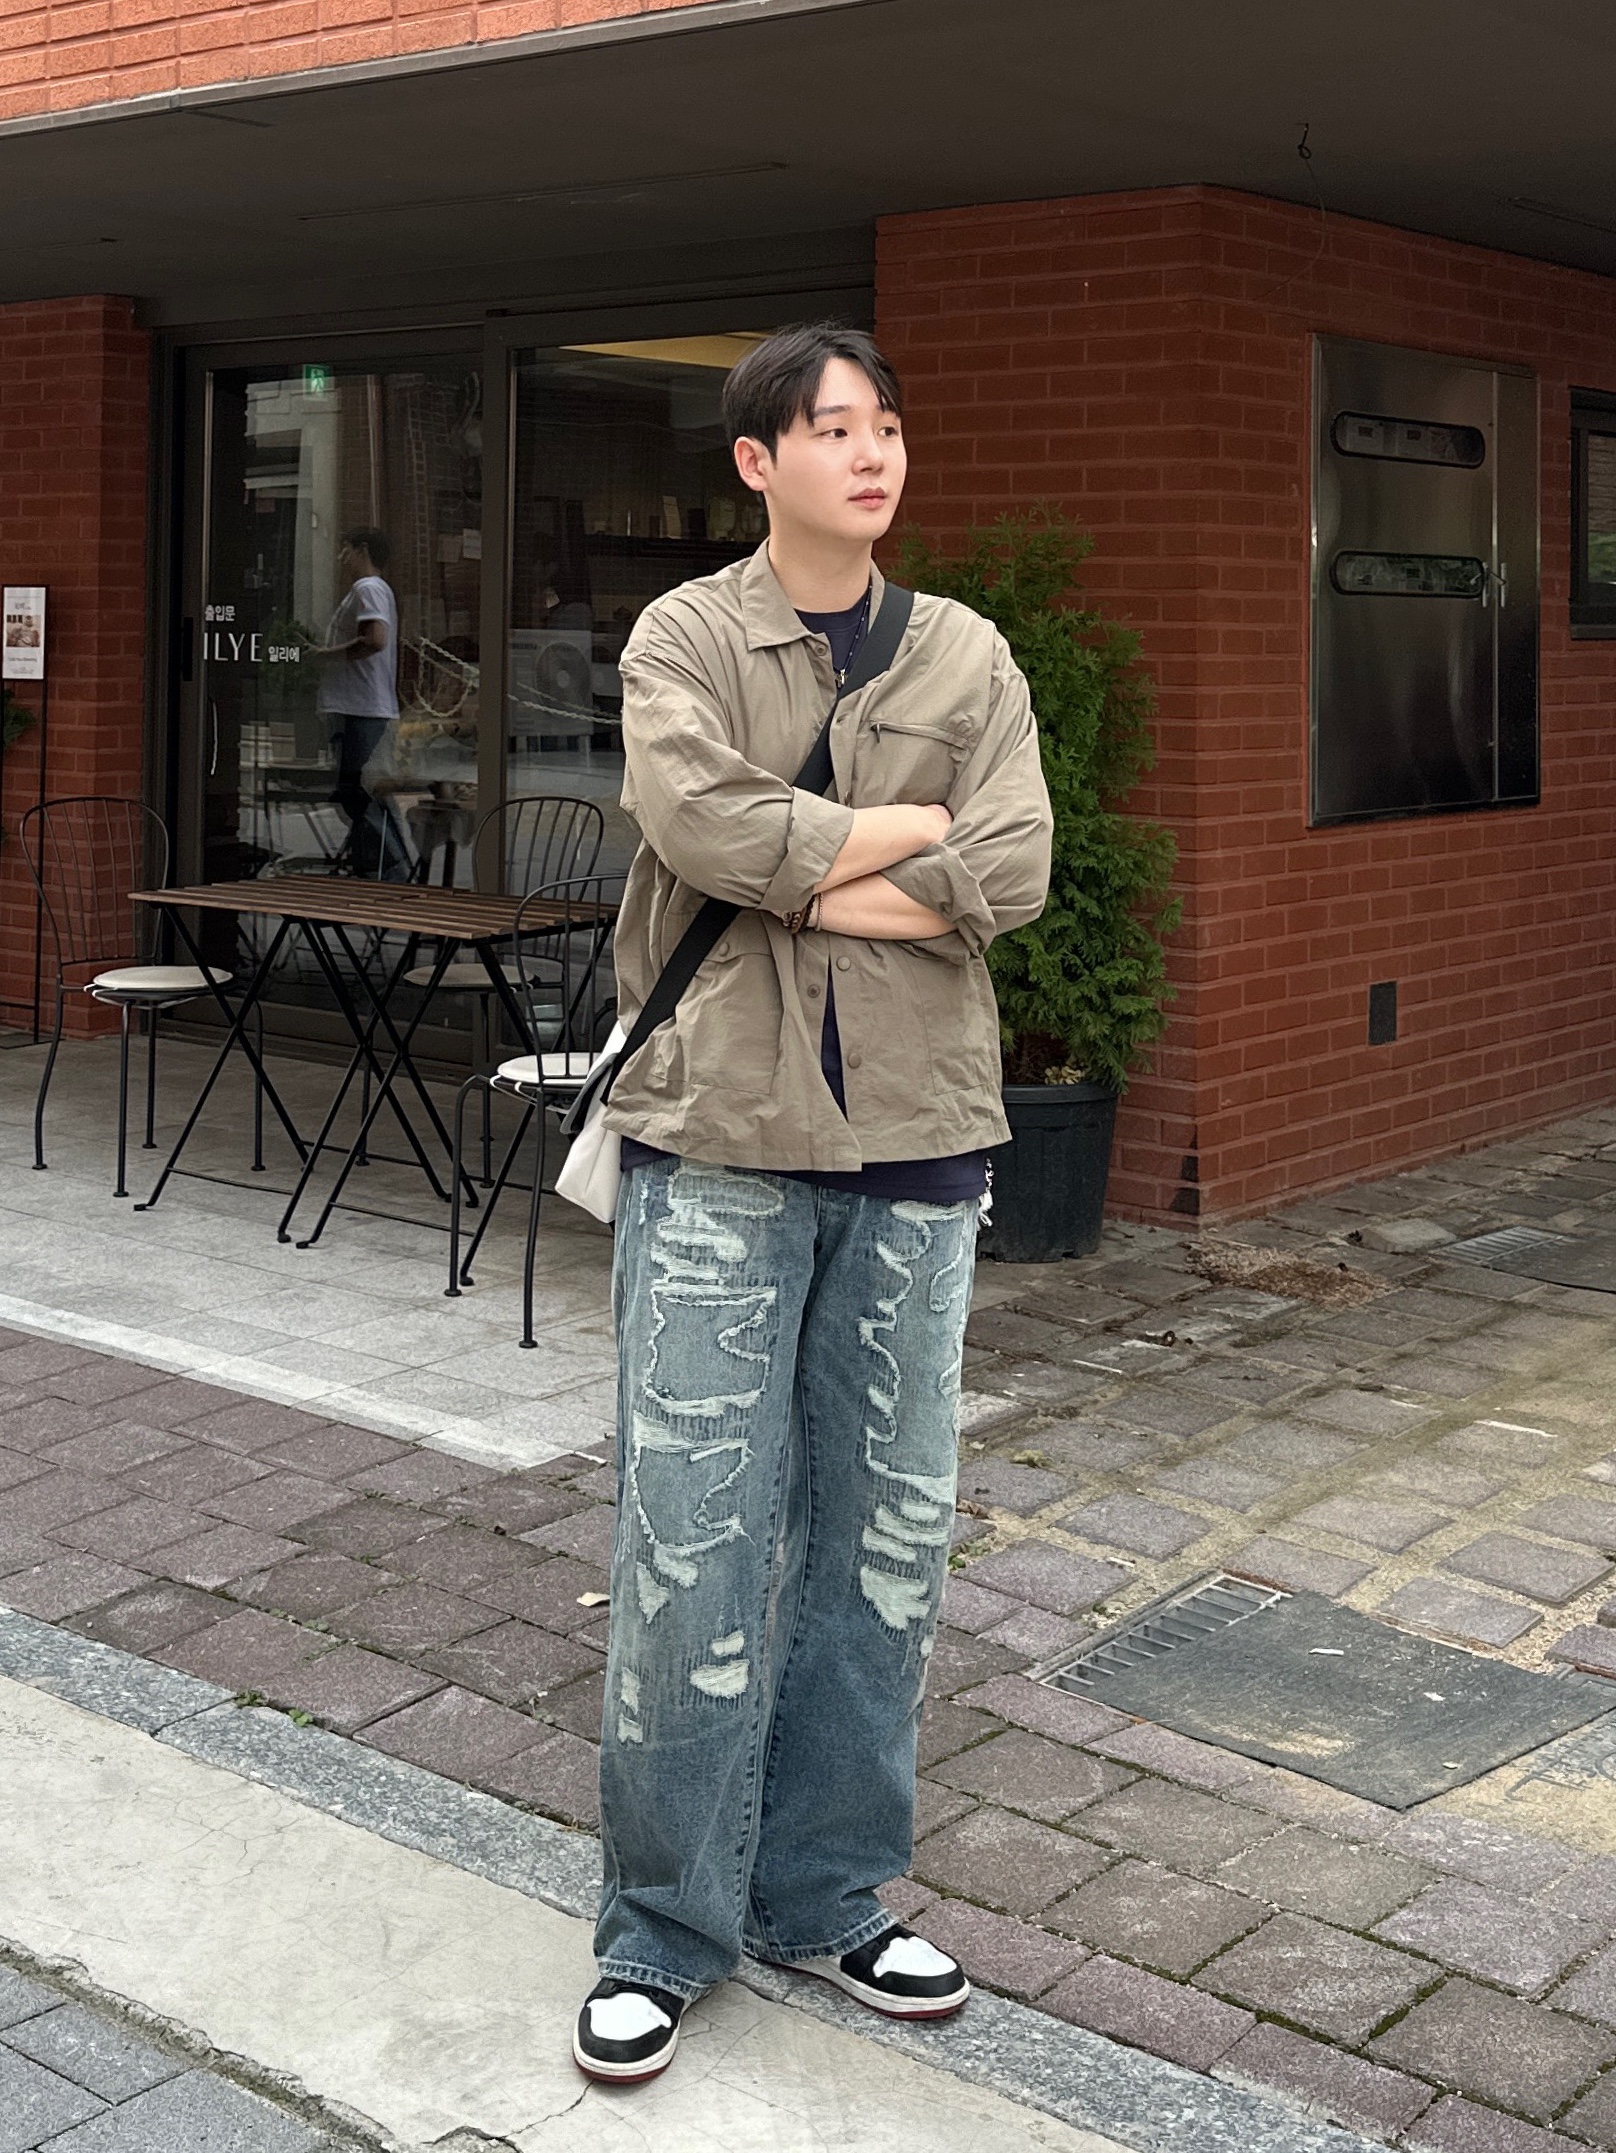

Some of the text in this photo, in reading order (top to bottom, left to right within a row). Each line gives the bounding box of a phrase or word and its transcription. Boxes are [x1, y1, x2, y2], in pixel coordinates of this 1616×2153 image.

[205, 604, 236, 622] 출입문
[203, 632, 300, 663] ILYE 일리에
